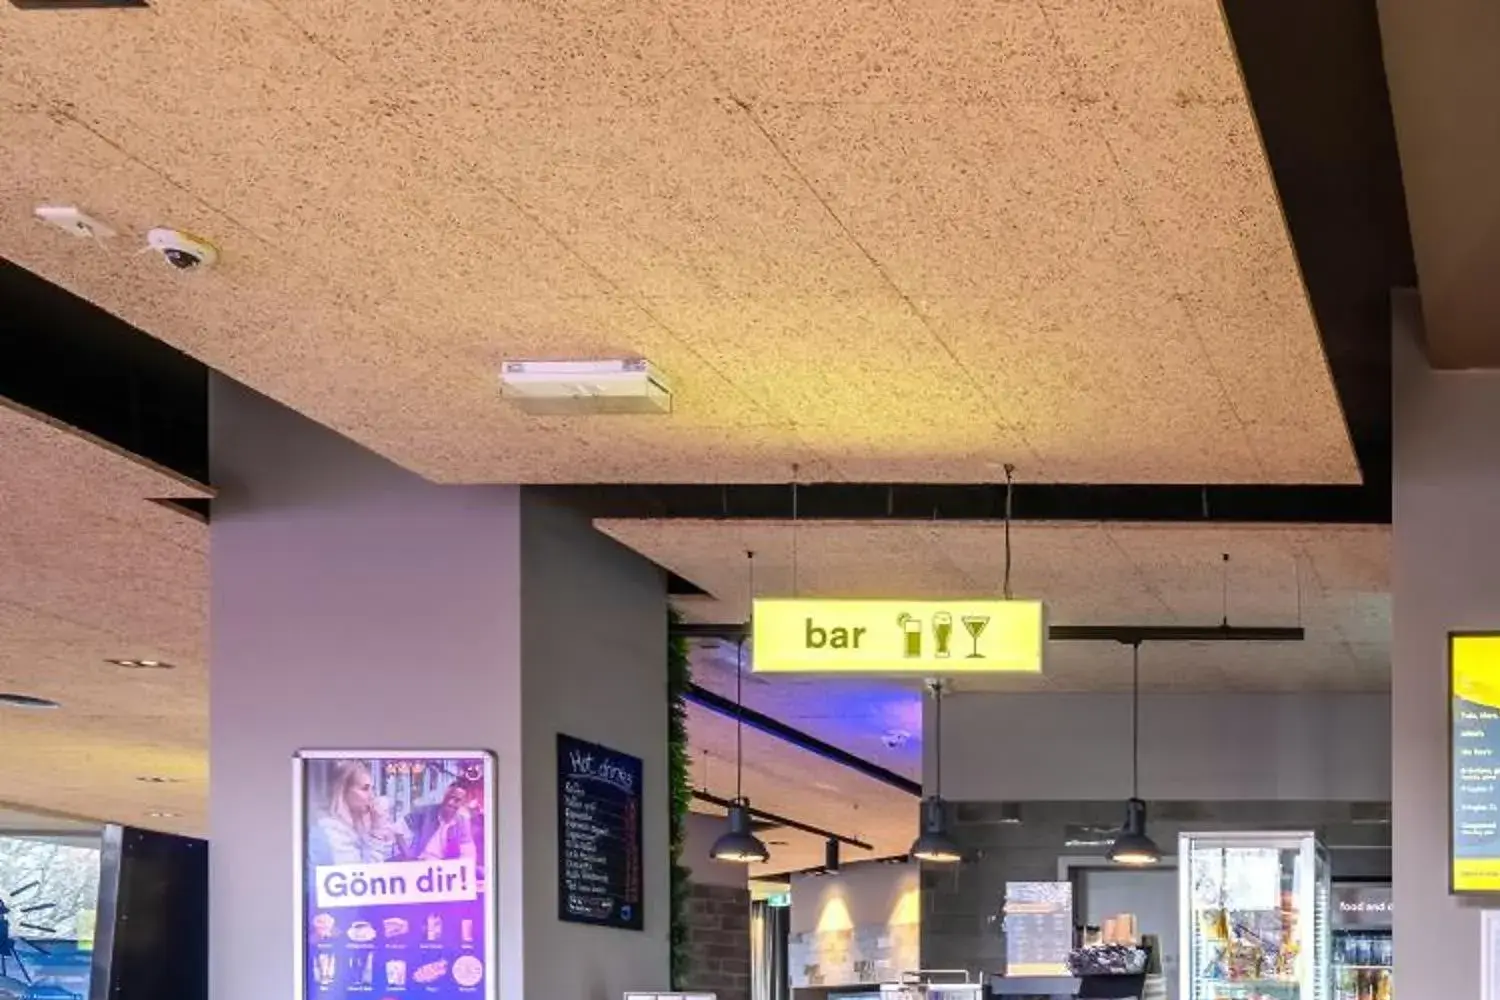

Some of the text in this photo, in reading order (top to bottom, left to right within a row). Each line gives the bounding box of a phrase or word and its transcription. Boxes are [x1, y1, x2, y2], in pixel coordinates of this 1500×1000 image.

[805, 617, 867, 649] bar
[324, 865, 468, 897] Gönn dir!
[1340, 901, 1364, 911] food
[1366, 901, 1385, 911] and
